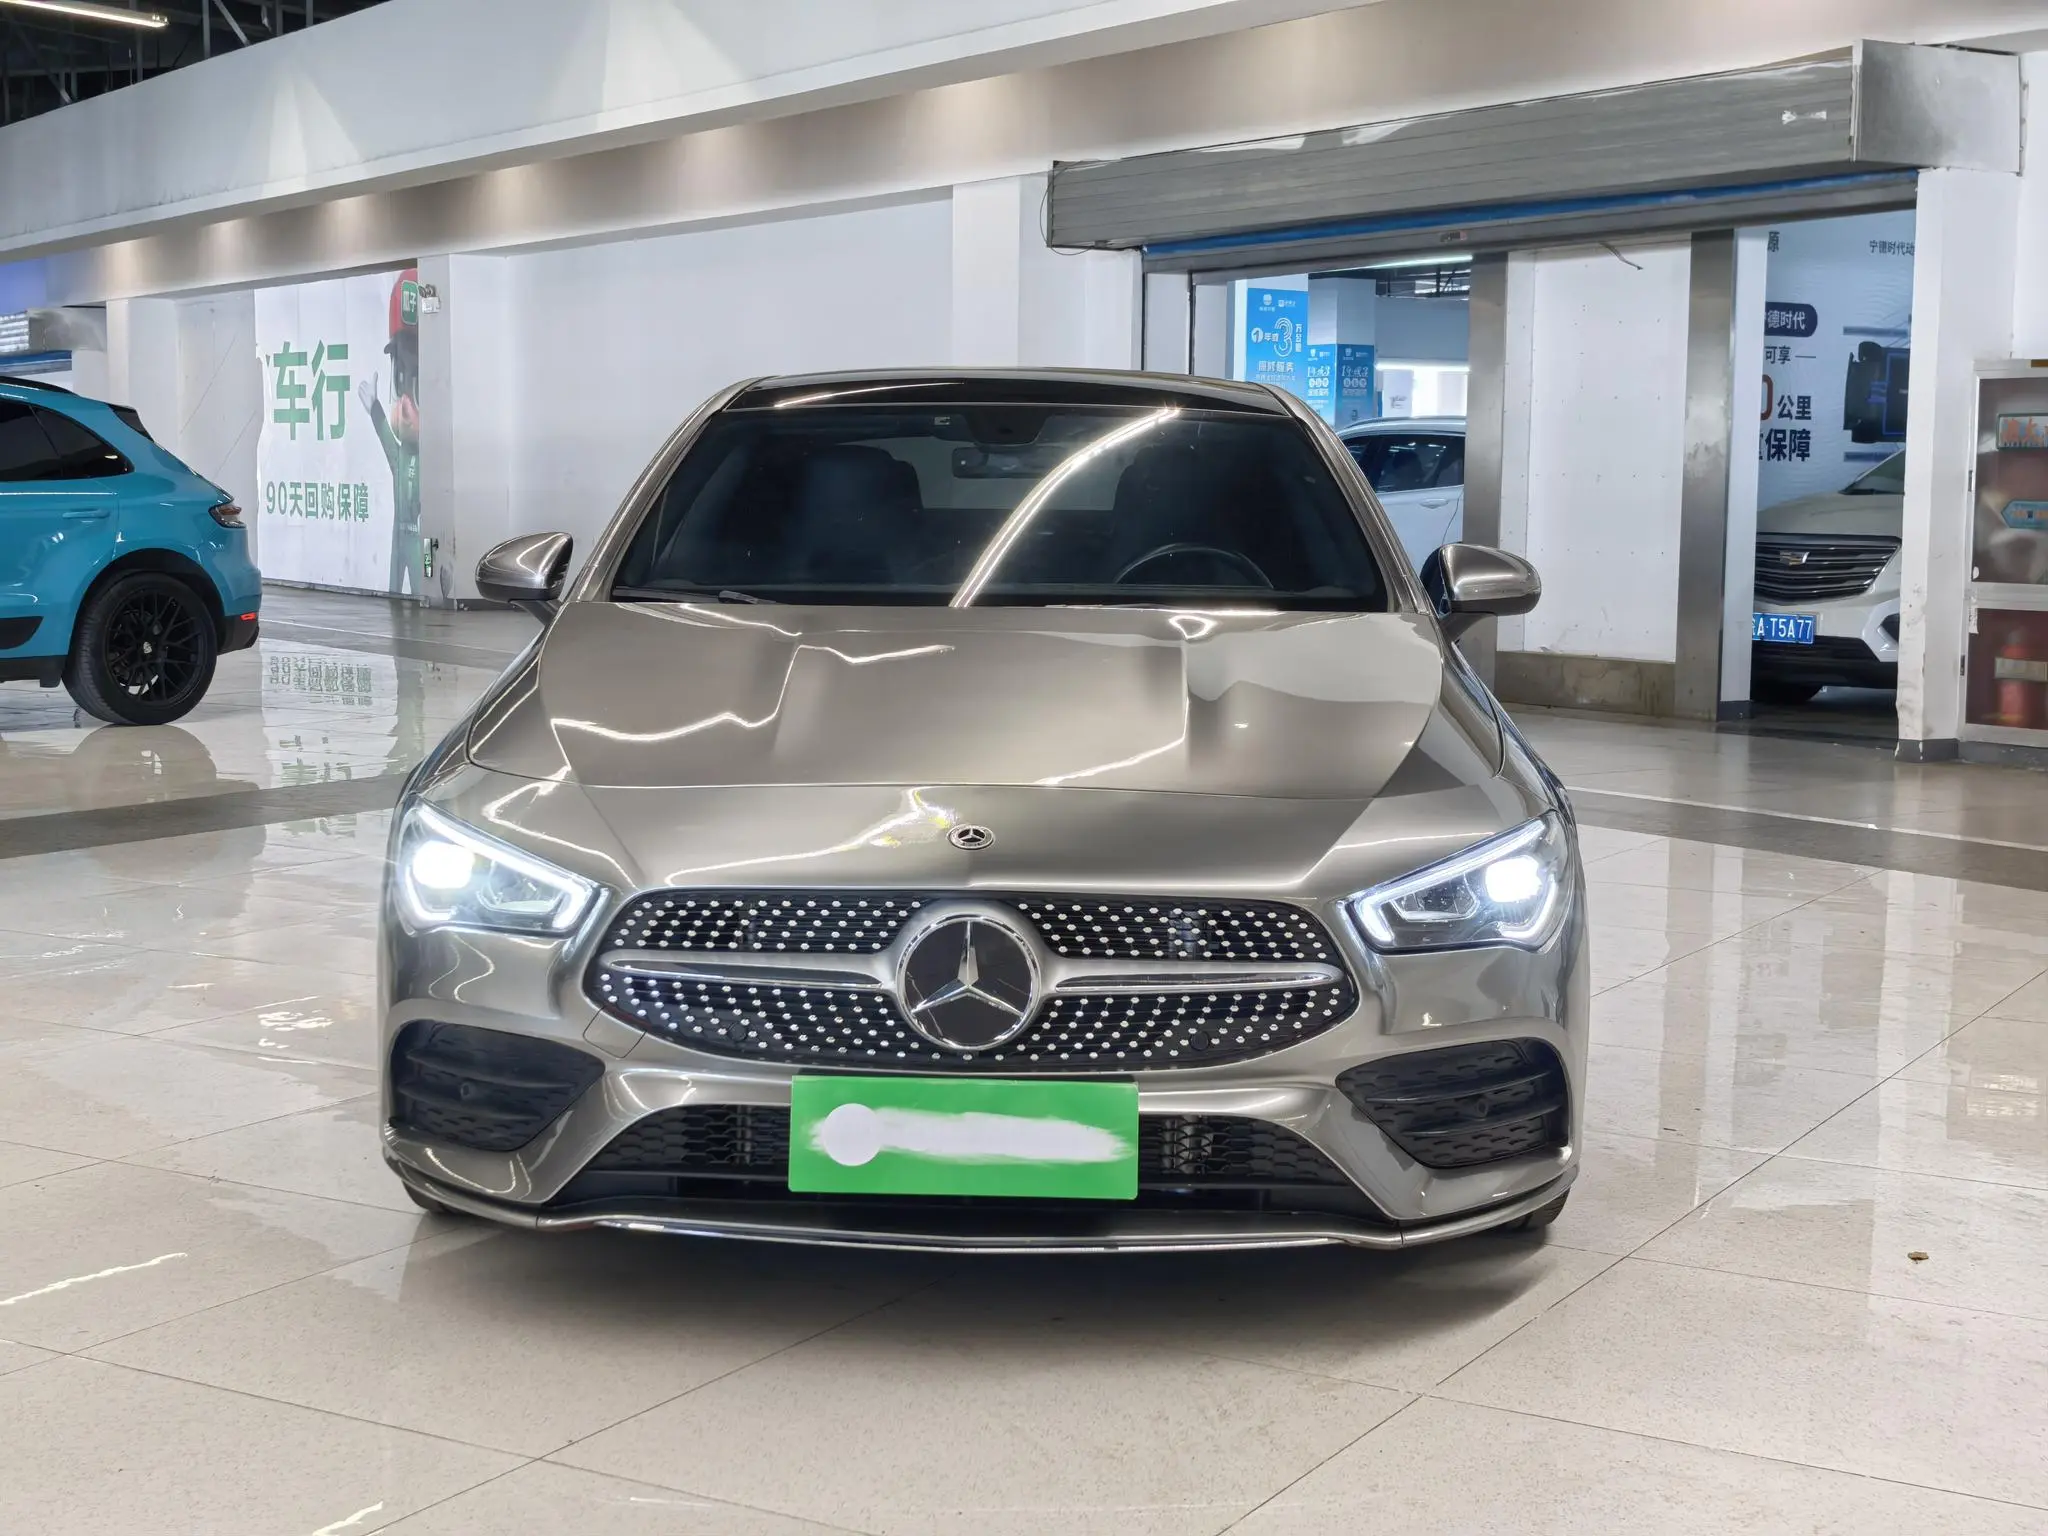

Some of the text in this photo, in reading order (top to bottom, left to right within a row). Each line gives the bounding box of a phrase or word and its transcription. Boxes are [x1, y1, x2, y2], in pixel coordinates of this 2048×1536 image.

[1765, 310, 1806, 330] 德时代
[265, 339, 351, 441] 车行
[1759, 428, 1811, 462] 保障
[266, 480, 370, 523] 90天回购保障
